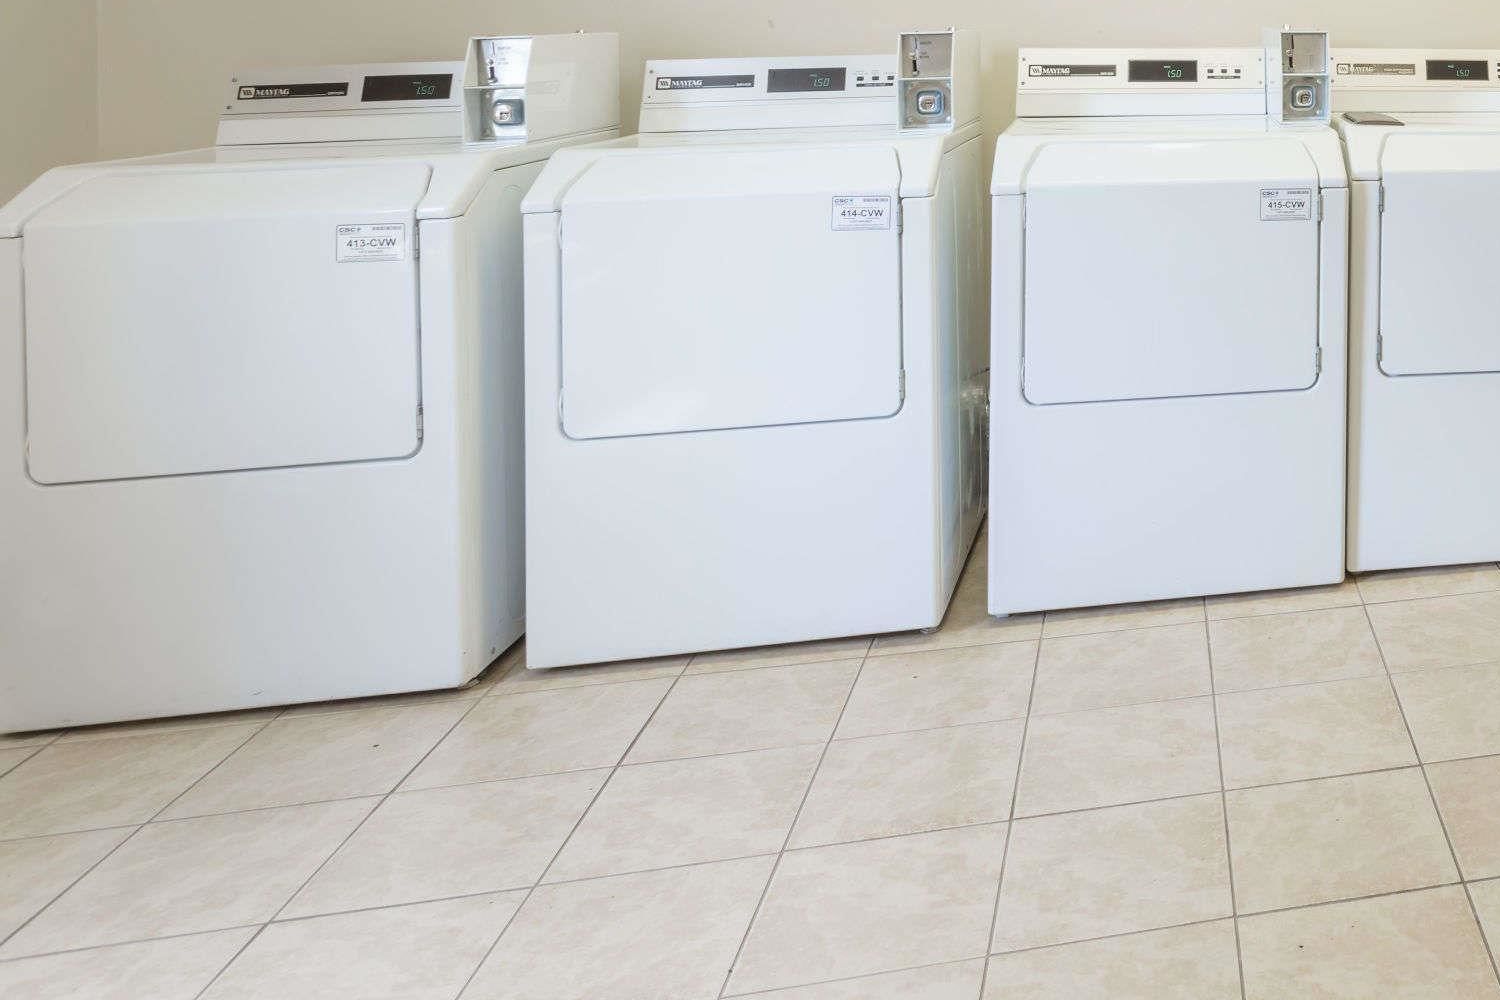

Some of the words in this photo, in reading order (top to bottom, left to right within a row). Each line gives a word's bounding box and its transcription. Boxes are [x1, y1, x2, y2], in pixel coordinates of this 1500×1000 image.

[671, 79, 704, 88] MAYTAG
[255, 88, 290, 96] MAYTAG
[1267, 200, 1306, 209] 415-CVW
[840, 208, 884, 217] 414-CVW
[346, 237, 397, 248] 413-CVW
